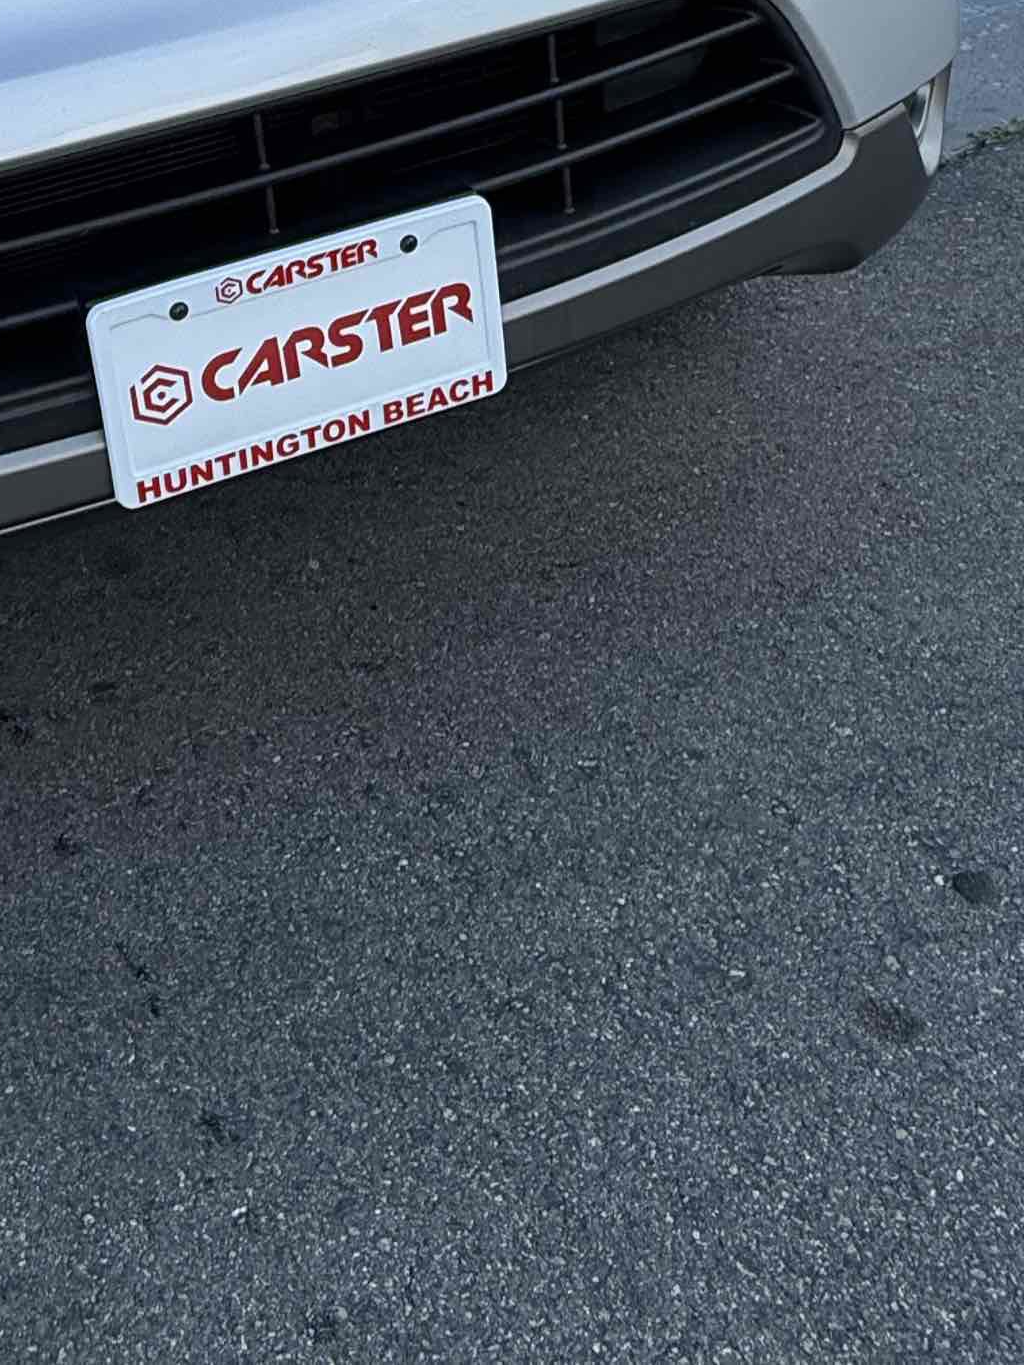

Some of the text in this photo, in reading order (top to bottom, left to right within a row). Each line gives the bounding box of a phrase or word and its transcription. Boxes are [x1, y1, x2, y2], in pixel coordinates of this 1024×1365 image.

[245, 238, 379, 295] CARSTER
[201, 282, 474, 402] CARSTER
[136, 370, 494, 503] HUNTINGTON BEACH
